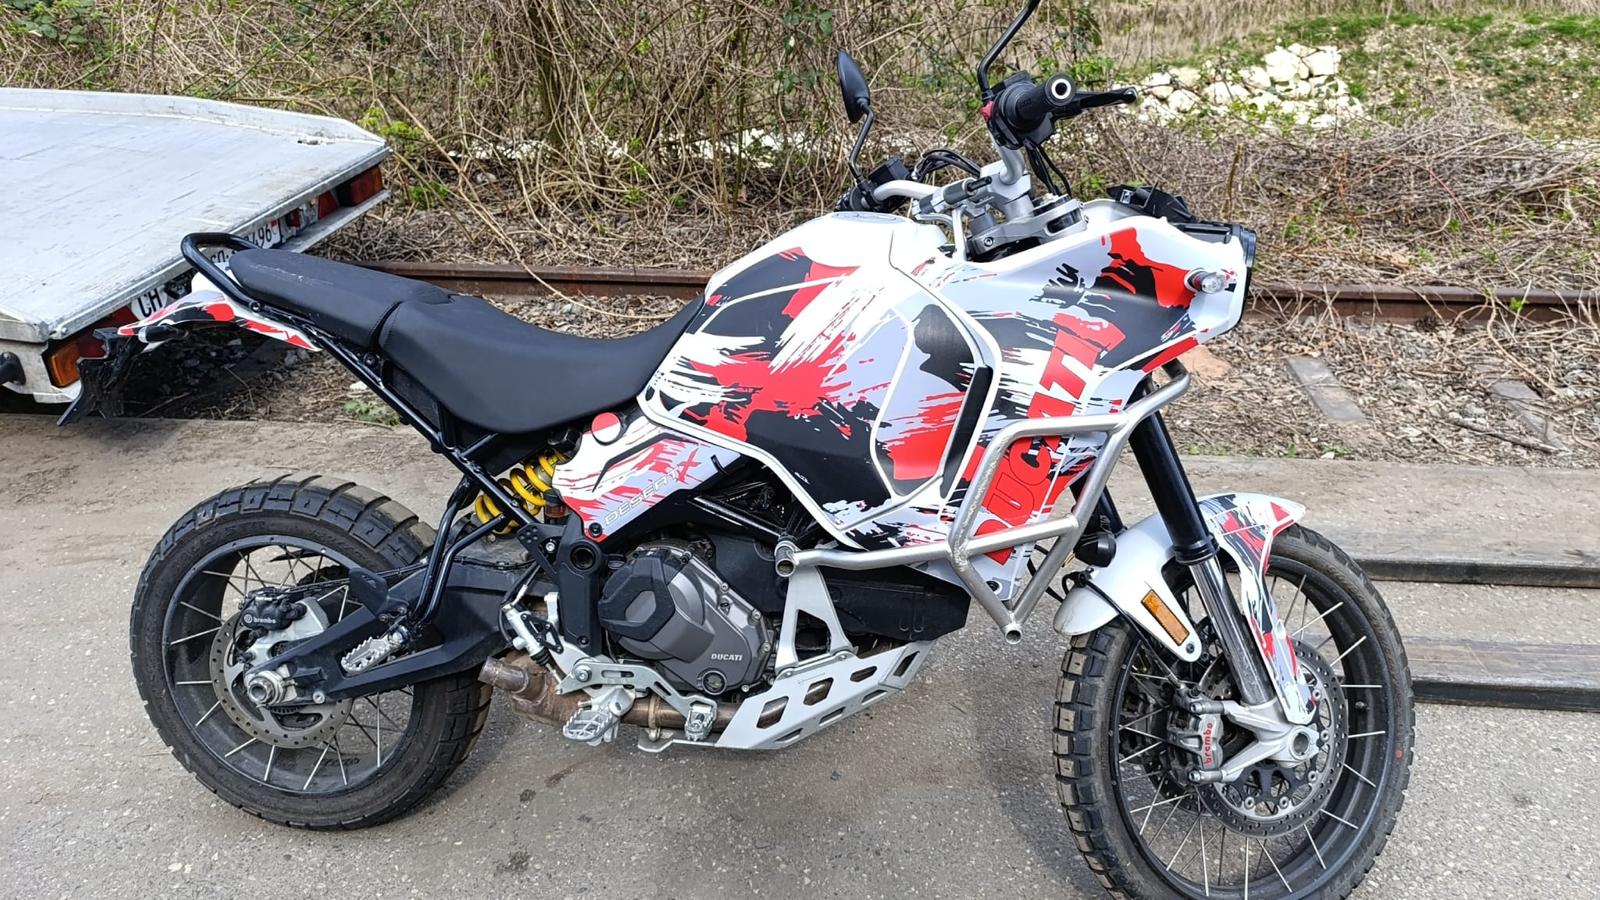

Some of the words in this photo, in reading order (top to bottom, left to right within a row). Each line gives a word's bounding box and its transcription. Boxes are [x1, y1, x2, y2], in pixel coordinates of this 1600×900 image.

[137, 287, 163, 318] CH
[253, 616, 277, 624] brembo
[710, 653, 743, 661] DUCATI
[1203, 722, 1214, 764] brembo
